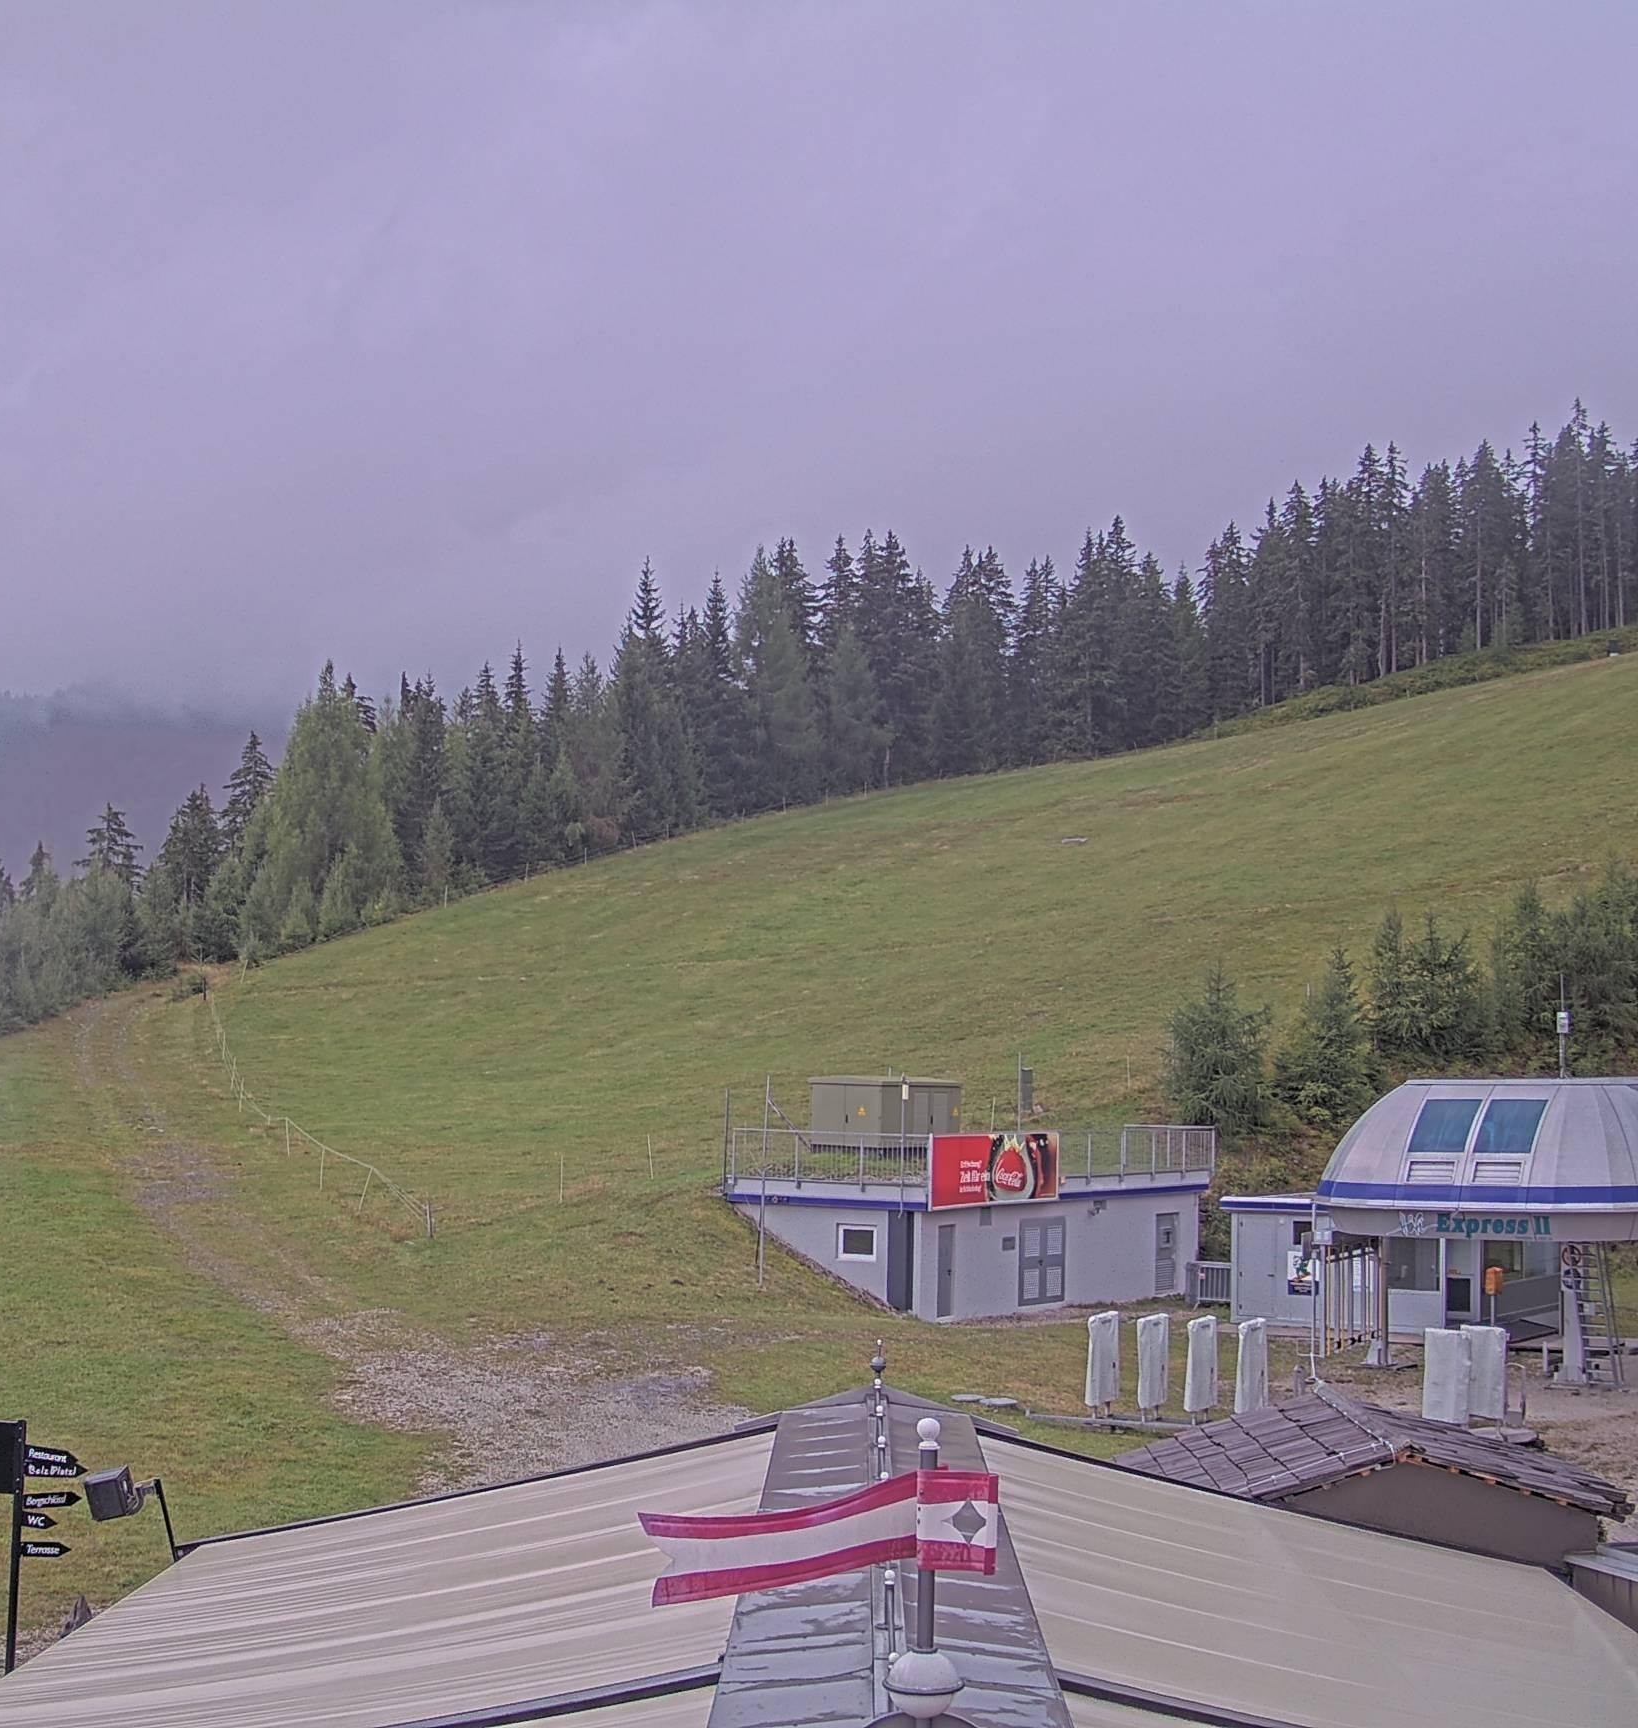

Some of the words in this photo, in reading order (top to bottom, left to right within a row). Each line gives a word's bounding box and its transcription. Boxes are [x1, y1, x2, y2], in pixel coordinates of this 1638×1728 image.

[1437, 1213, 1529, 1239] Express
[28, 1448, 67, 1463] Restaurant
[27, 1515, 46, 1527] WC
[26, 1543, 61, 1555] Terrasse
